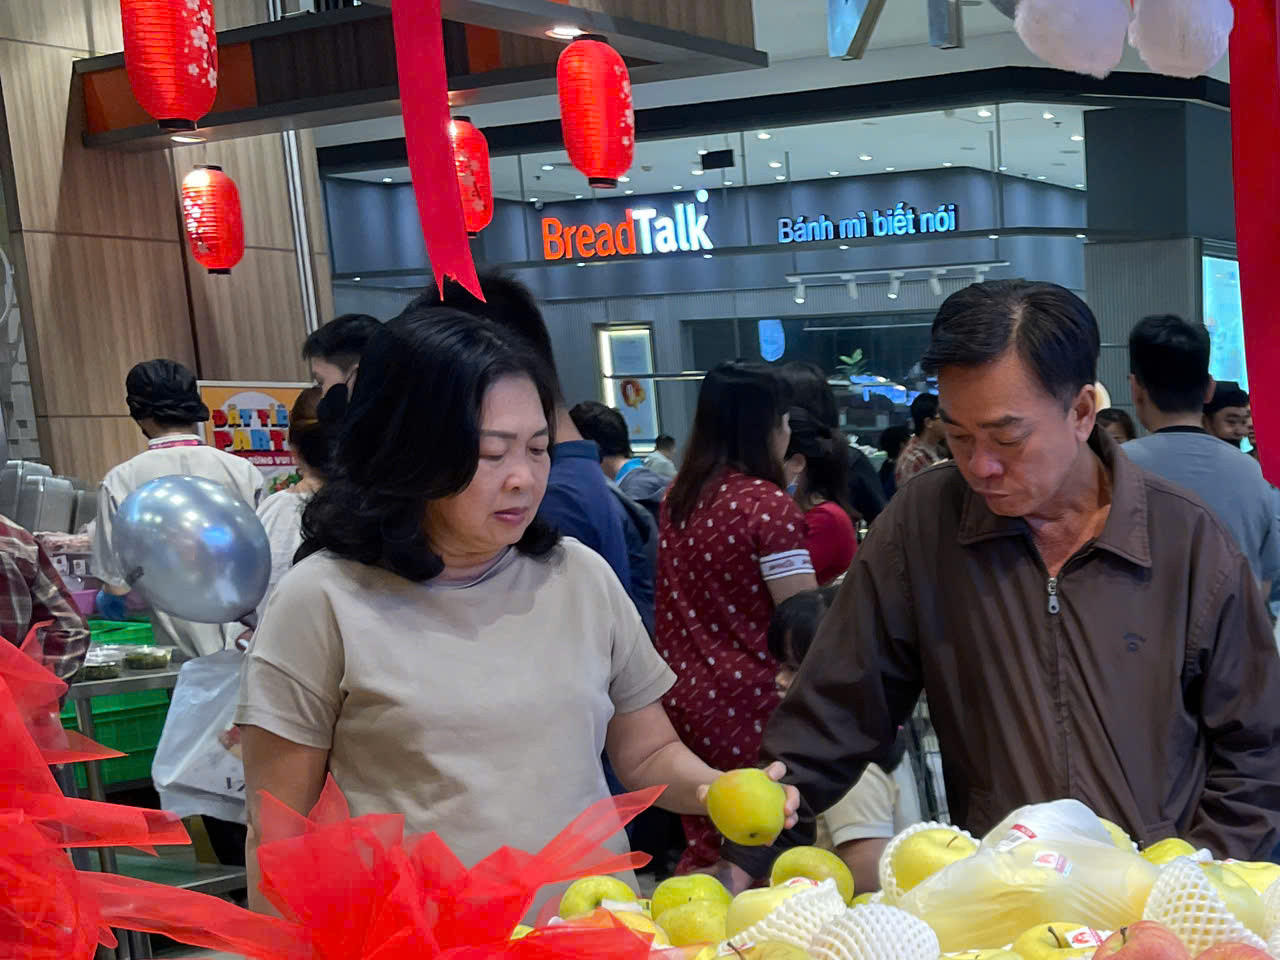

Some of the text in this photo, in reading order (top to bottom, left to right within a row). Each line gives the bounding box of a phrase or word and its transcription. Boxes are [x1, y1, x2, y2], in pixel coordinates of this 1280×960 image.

[541, 202, 714, 261] BreadTalk
[778, 201, 956, 243] Bánh mì biết nói
[213, 428, 287, 452] PART
